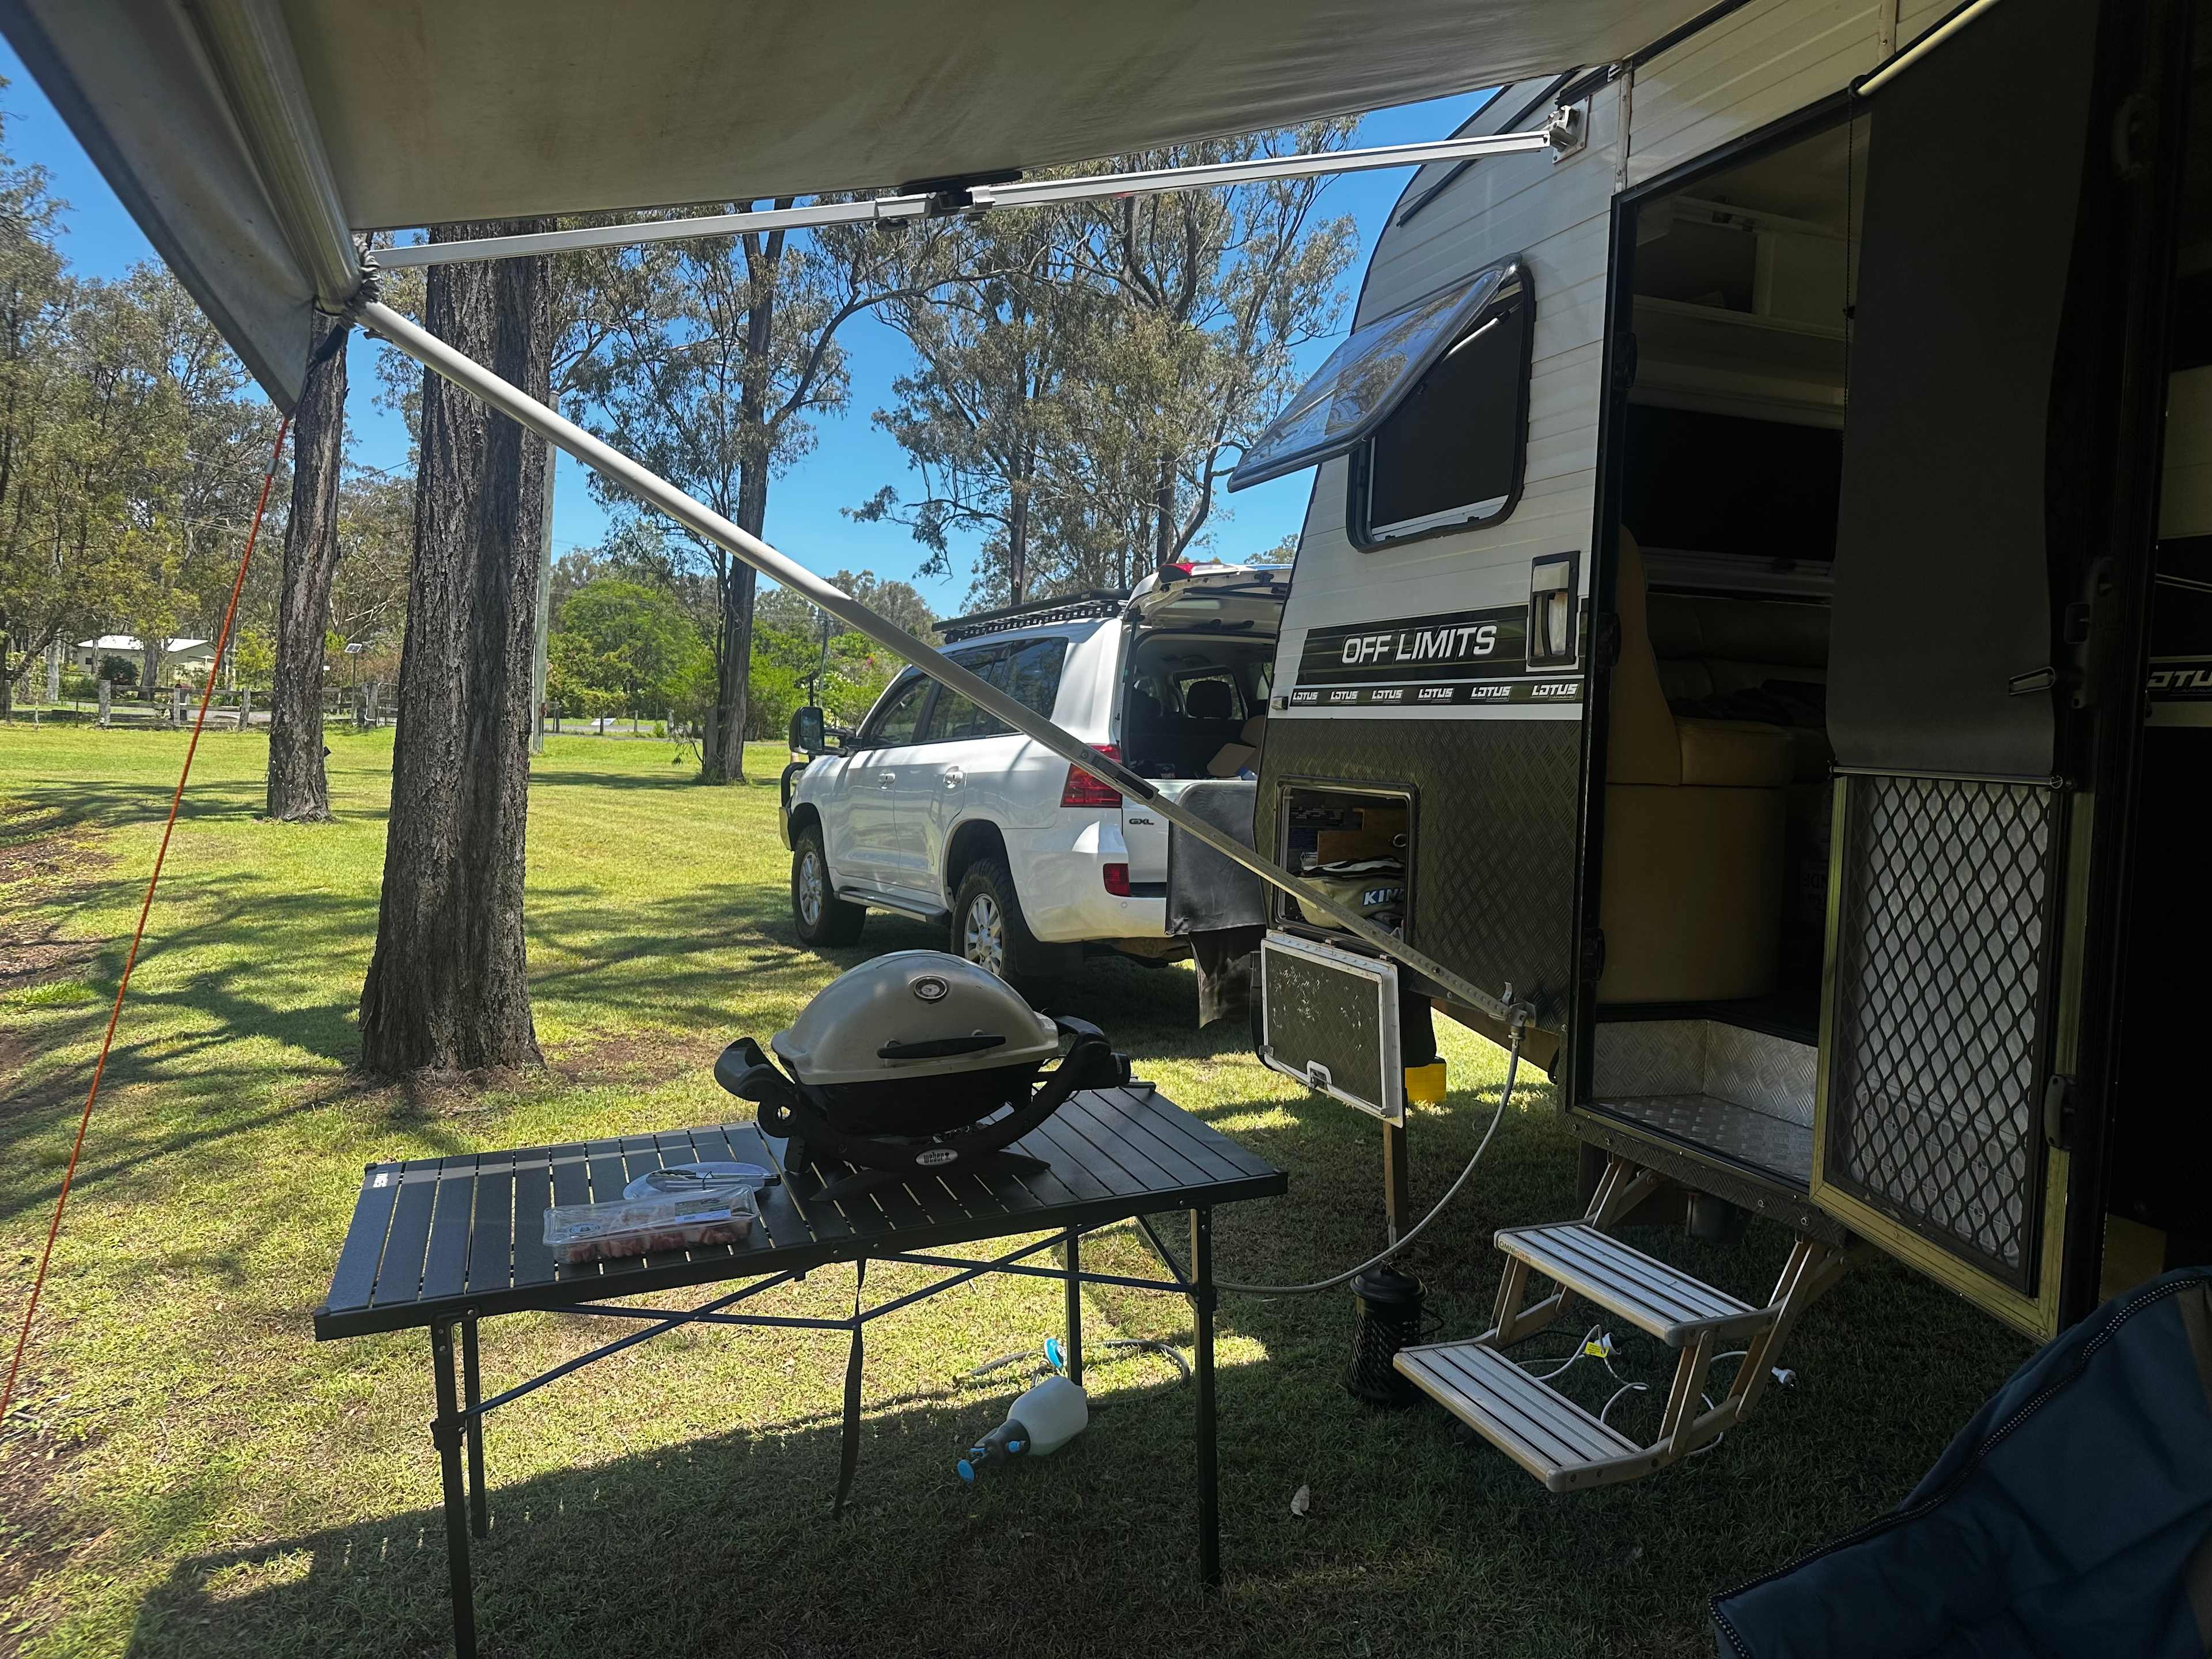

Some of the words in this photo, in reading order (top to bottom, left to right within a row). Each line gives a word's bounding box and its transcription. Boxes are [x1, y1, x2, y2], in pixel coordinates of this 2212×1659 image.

[1342, 635, 1392, 664] OFF
[1396, 626, 1497, 661] LIMITS
[2147, 671, 2212, 687] OTU
[1293, 692, 1318, 700] LOTUS
[1330, 691, 1358, 700] LOTUS
[1372, 690, 1403, 699] LOTUS
[1418, 688, 1453, 698] LOTUS
[1471, 685, 1512, 697] LOTUS
[1532, 684, 1578, 696] LOTUS
[923, 1152, 944, 1164] weber
